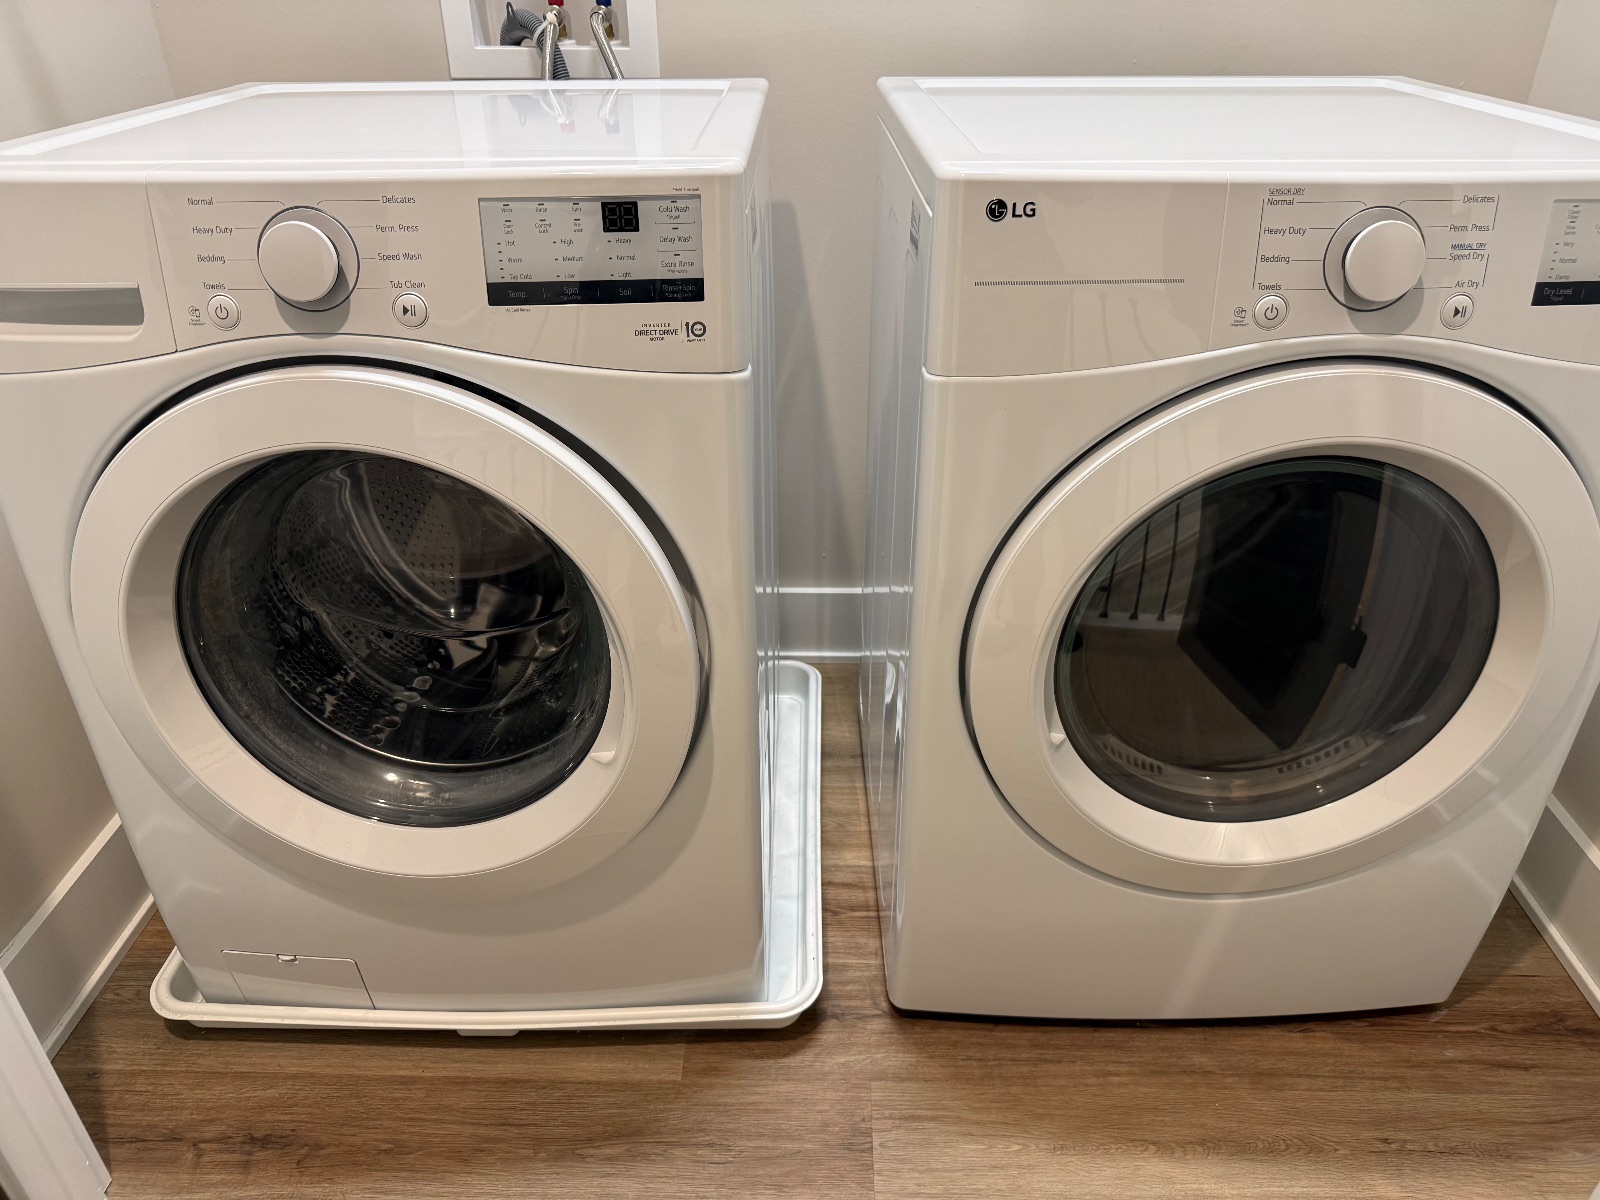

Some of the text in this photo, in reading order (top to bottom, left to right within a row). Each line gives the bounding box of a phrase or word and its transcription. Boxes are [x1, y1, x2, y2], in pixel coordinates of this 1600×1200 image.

[1268, 187, 1306, 195] SENSOR DRY
[187, 196, 214, 206] Normal
[381, 195, 417, 204] Delicates
[1266, 197, 1295, 206] Normal
[1462, 194, 1496, 204] Delicates
[658, 204, 690, 213] Cold Wash
[1011, 200, 1037, 219] LG
[192, 225, 233, 237] Heavy Duty
[375, 223, 420, 233] Perm. Press
[1263, 226, 1307, 237] Heavy Duty
[1449, 223, 1491, 232] Perm. Press
[560, 238, 574, 246] High
[615, 237, 632, 246] Heavy
[659, 235, 694, 245] Delay Wash
[197, 253, 226, 265] Bedding
[377, 251, 423, 263] Speed Wash
[1260, 254, 1290, 265] Bedding
[1449, 251, 1486, 263] Speed Dry
[660, 260, 695, 268] Extra Rinse
[202, 281, 226, 291] Towels
[389, 280, 426, 289] Tub Clean
[662, 284, 696, 293] Rinse+Spin
[1257, 282, 1282, 291] Towels
[1454, 279, 1480, 290] Air Dry
[508, 290, 528, 299] Temp.
[563, 286, 579, 295] Spin
[619, 288, 632, 296] Soil
[1543, 286, 1573, 296] Dry Level
[634, 328, 679, 337] DIRECT DRIVE
